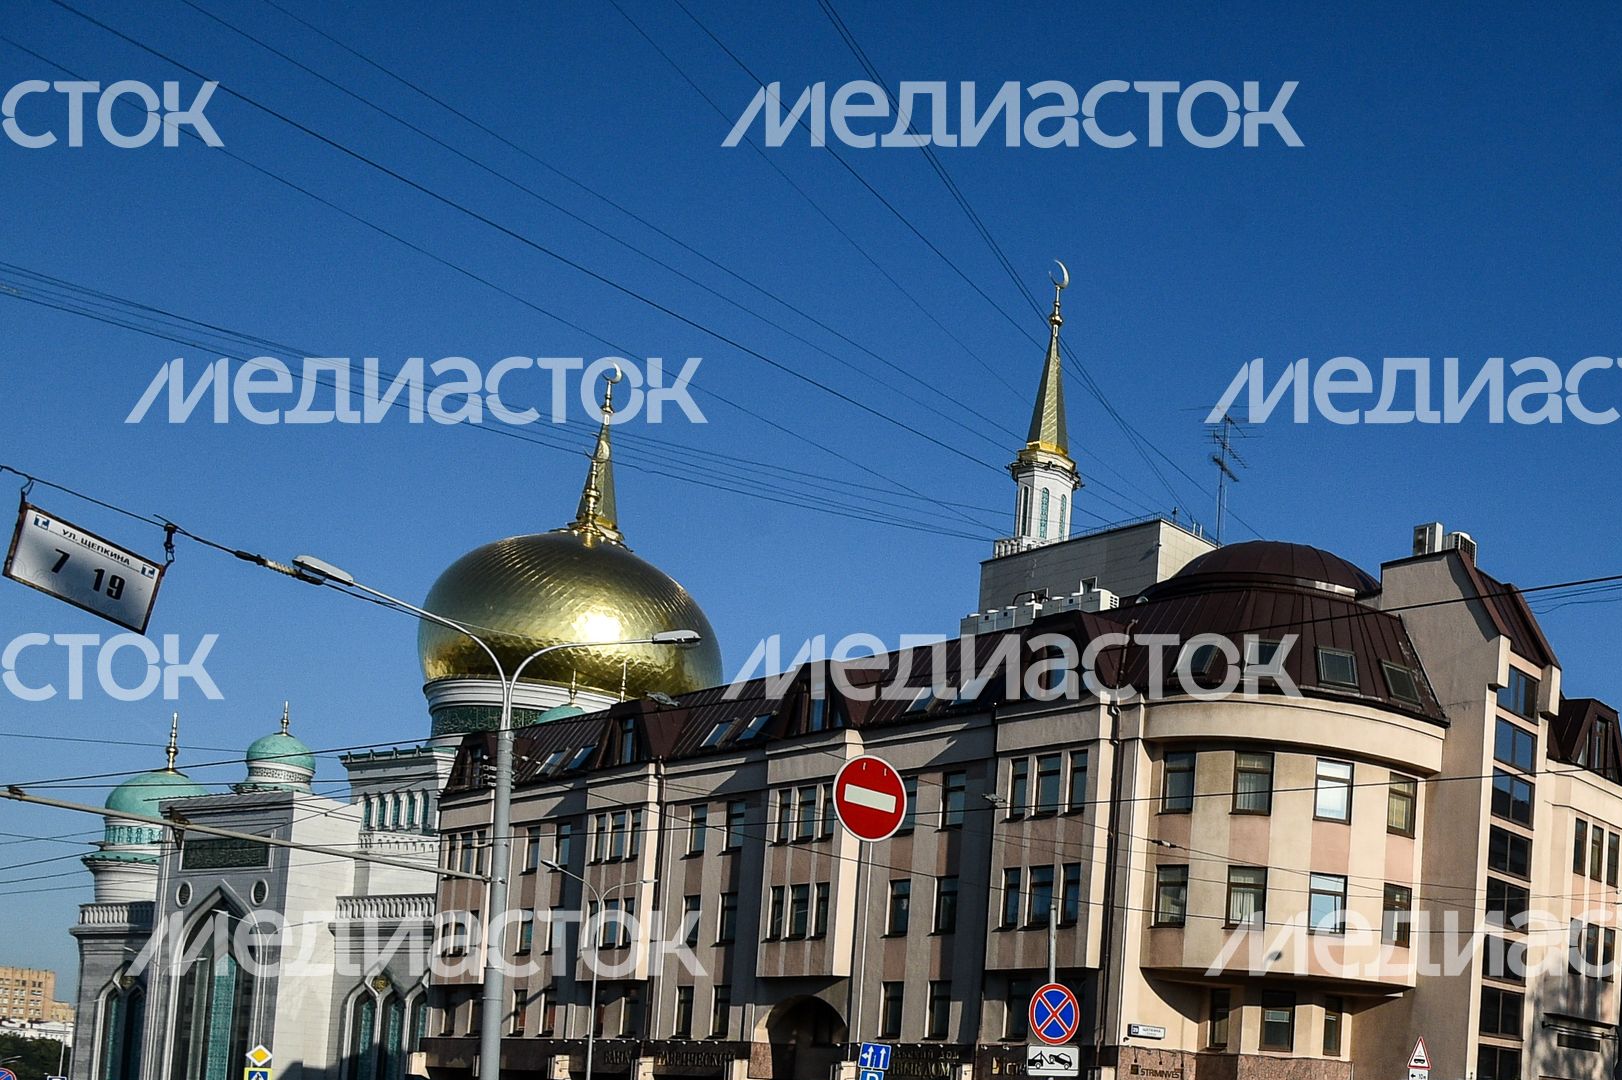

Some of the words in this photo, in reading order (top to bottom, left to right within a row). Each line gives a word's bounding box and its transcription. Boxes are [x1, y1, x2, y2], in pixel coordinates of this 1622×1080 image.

[81, 537, 130, 566] ЩЕПКИНА
[51, 548, 70, 574] 7
[92, 567, 126, 601] 19
